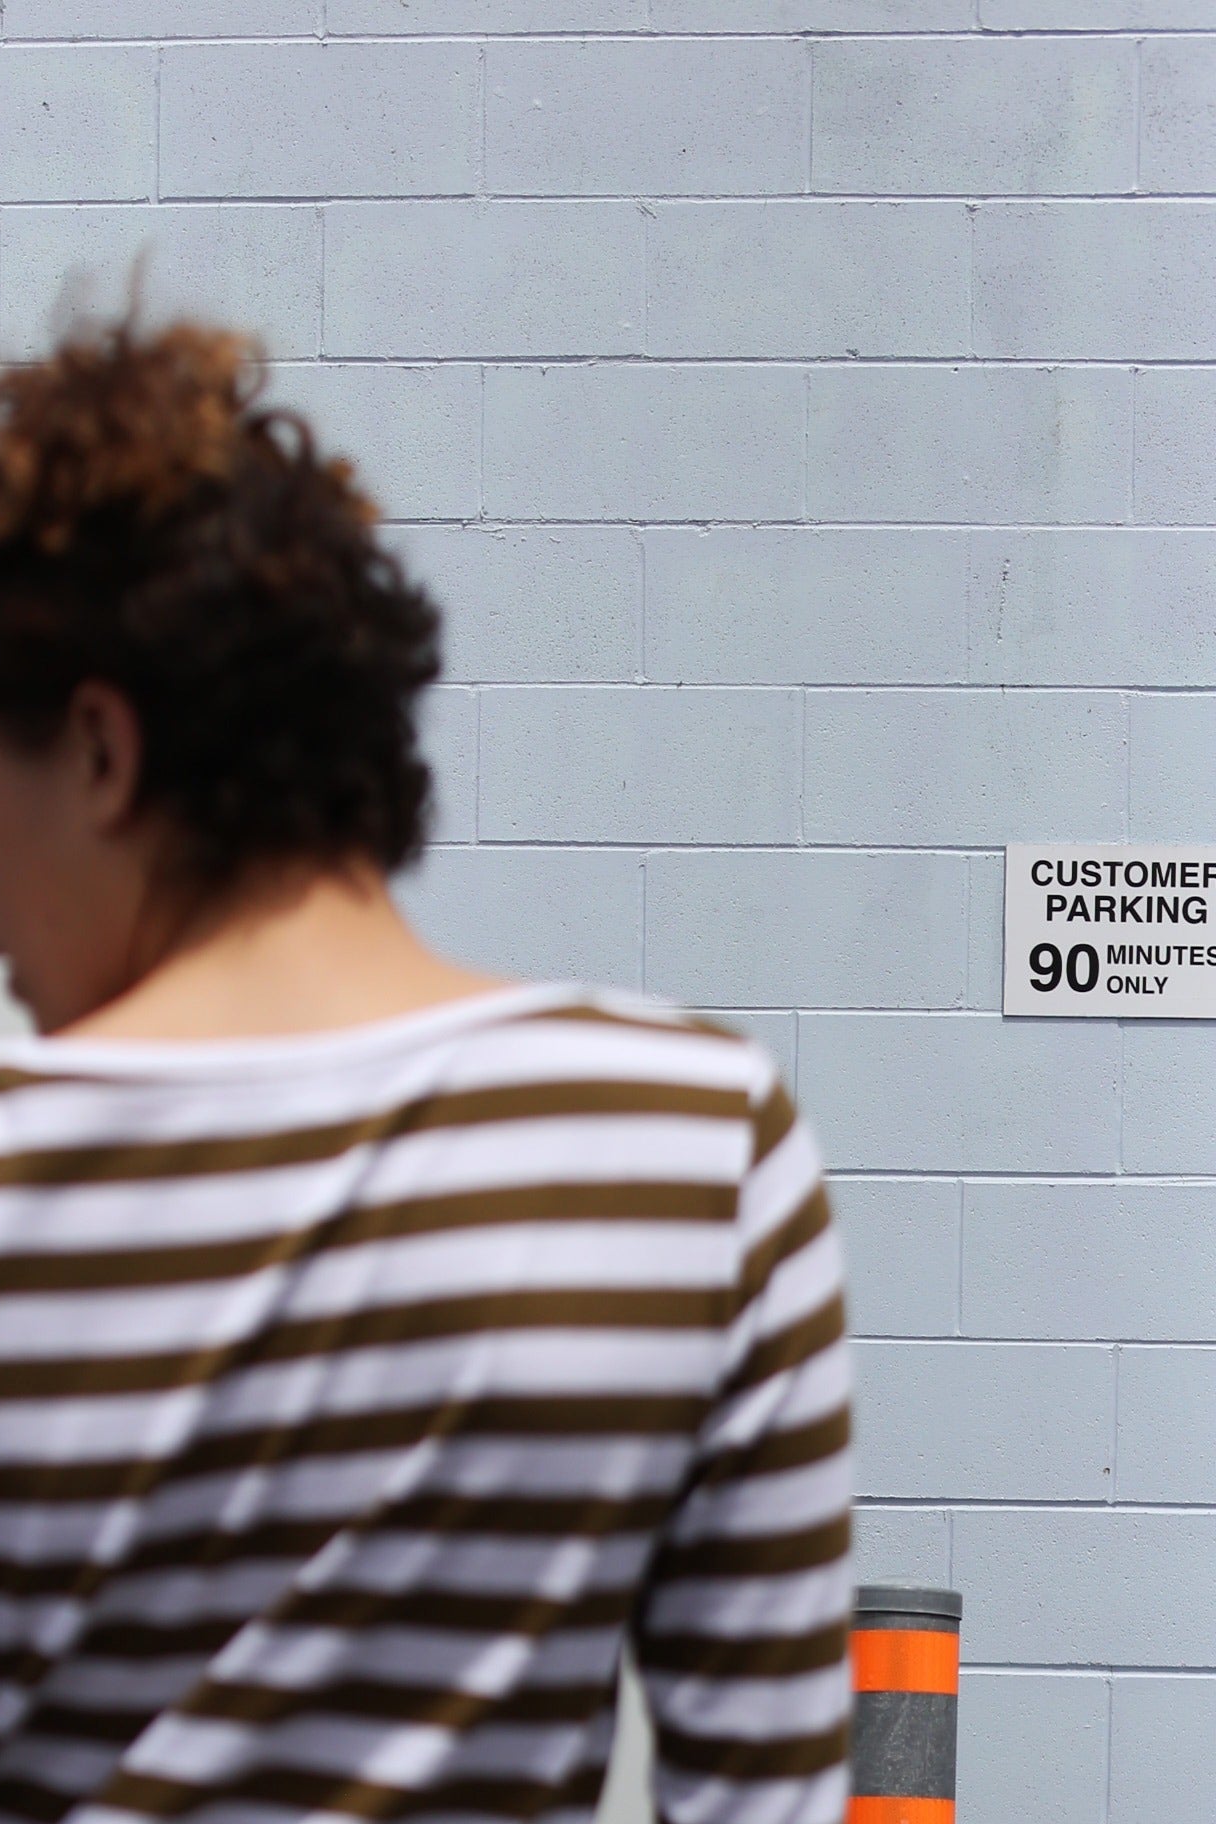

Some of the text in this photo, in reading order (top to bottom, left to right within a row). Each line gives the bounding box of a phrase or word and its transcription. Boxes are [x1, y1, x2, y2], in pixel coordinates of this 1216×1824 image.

[1046, 895, 1207, 924] PARKING
[1029, 942, 1216, 992] 90 MINUTES
[1107, 975, 1169, 994] ONLY
